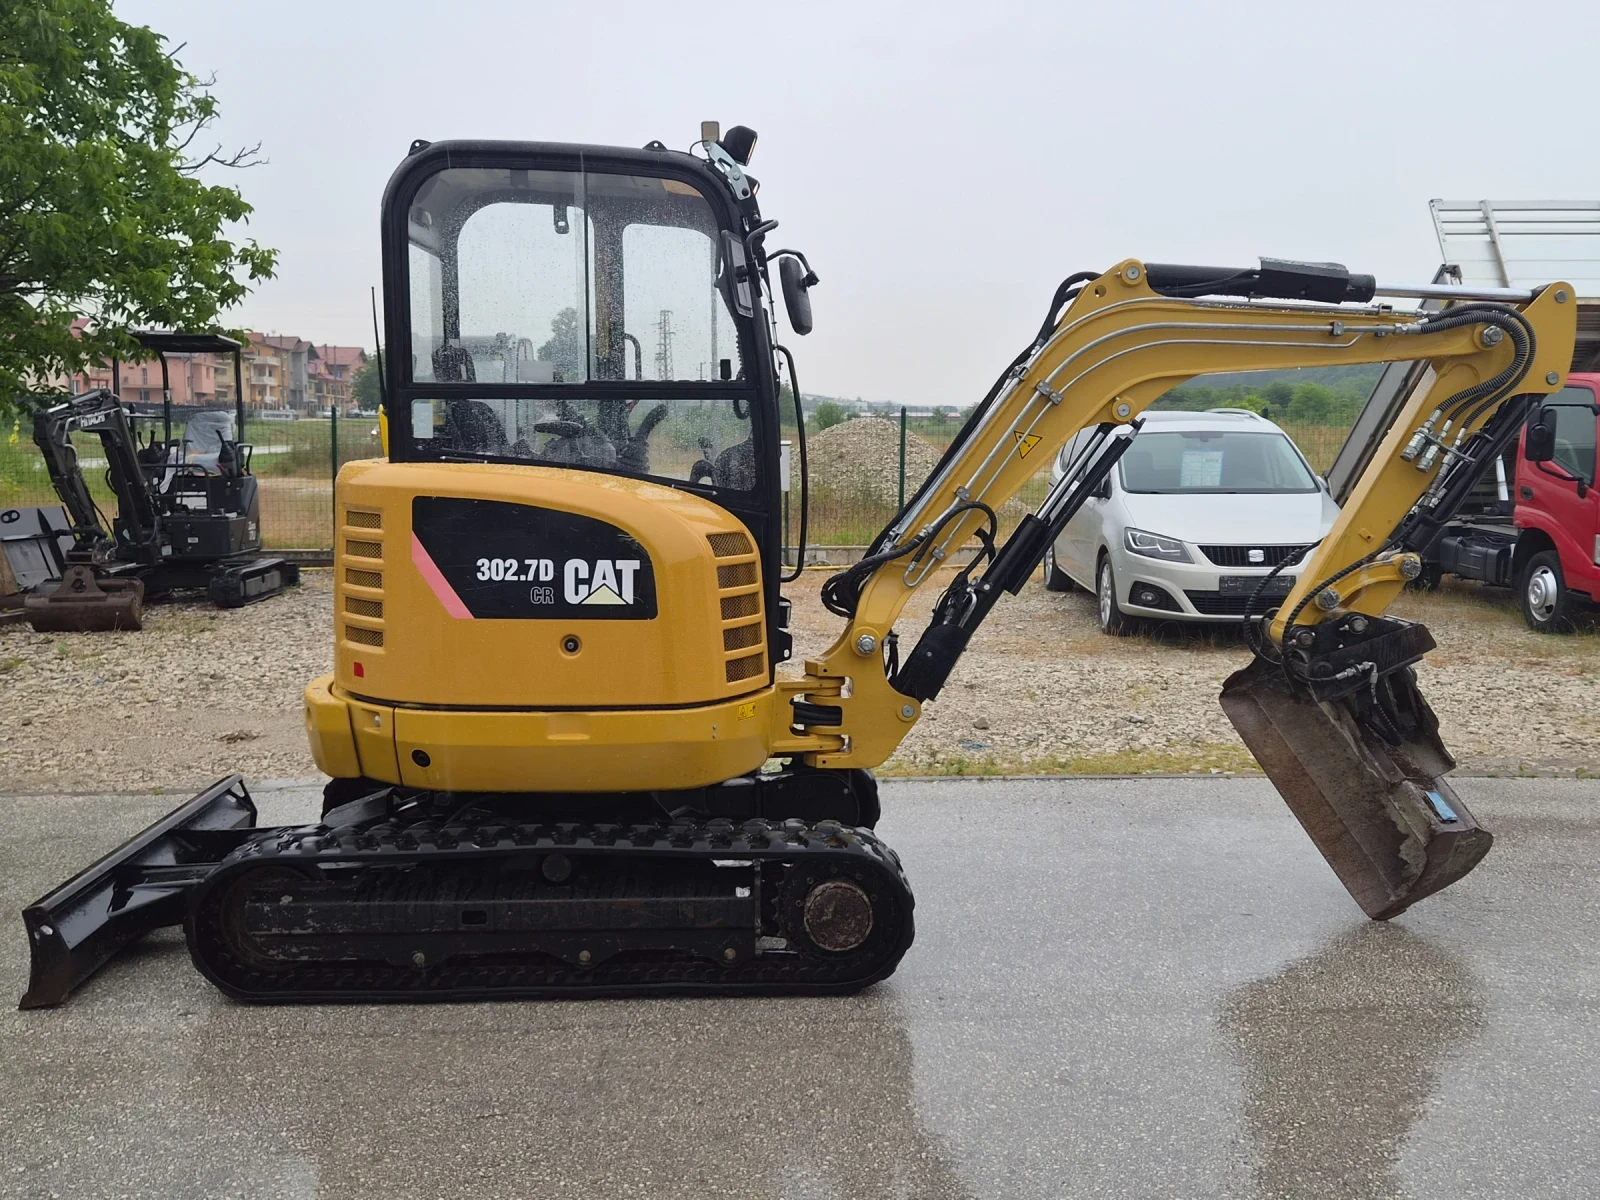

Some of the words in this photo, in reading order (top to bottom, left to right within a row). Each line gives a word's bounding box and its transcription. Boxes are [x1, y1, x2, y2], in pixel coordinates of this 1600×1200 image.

[476, 558, 554, 581] 302.7D
[564, 558, 641, 605] CAT
[530, 586, 554, 604] CR
